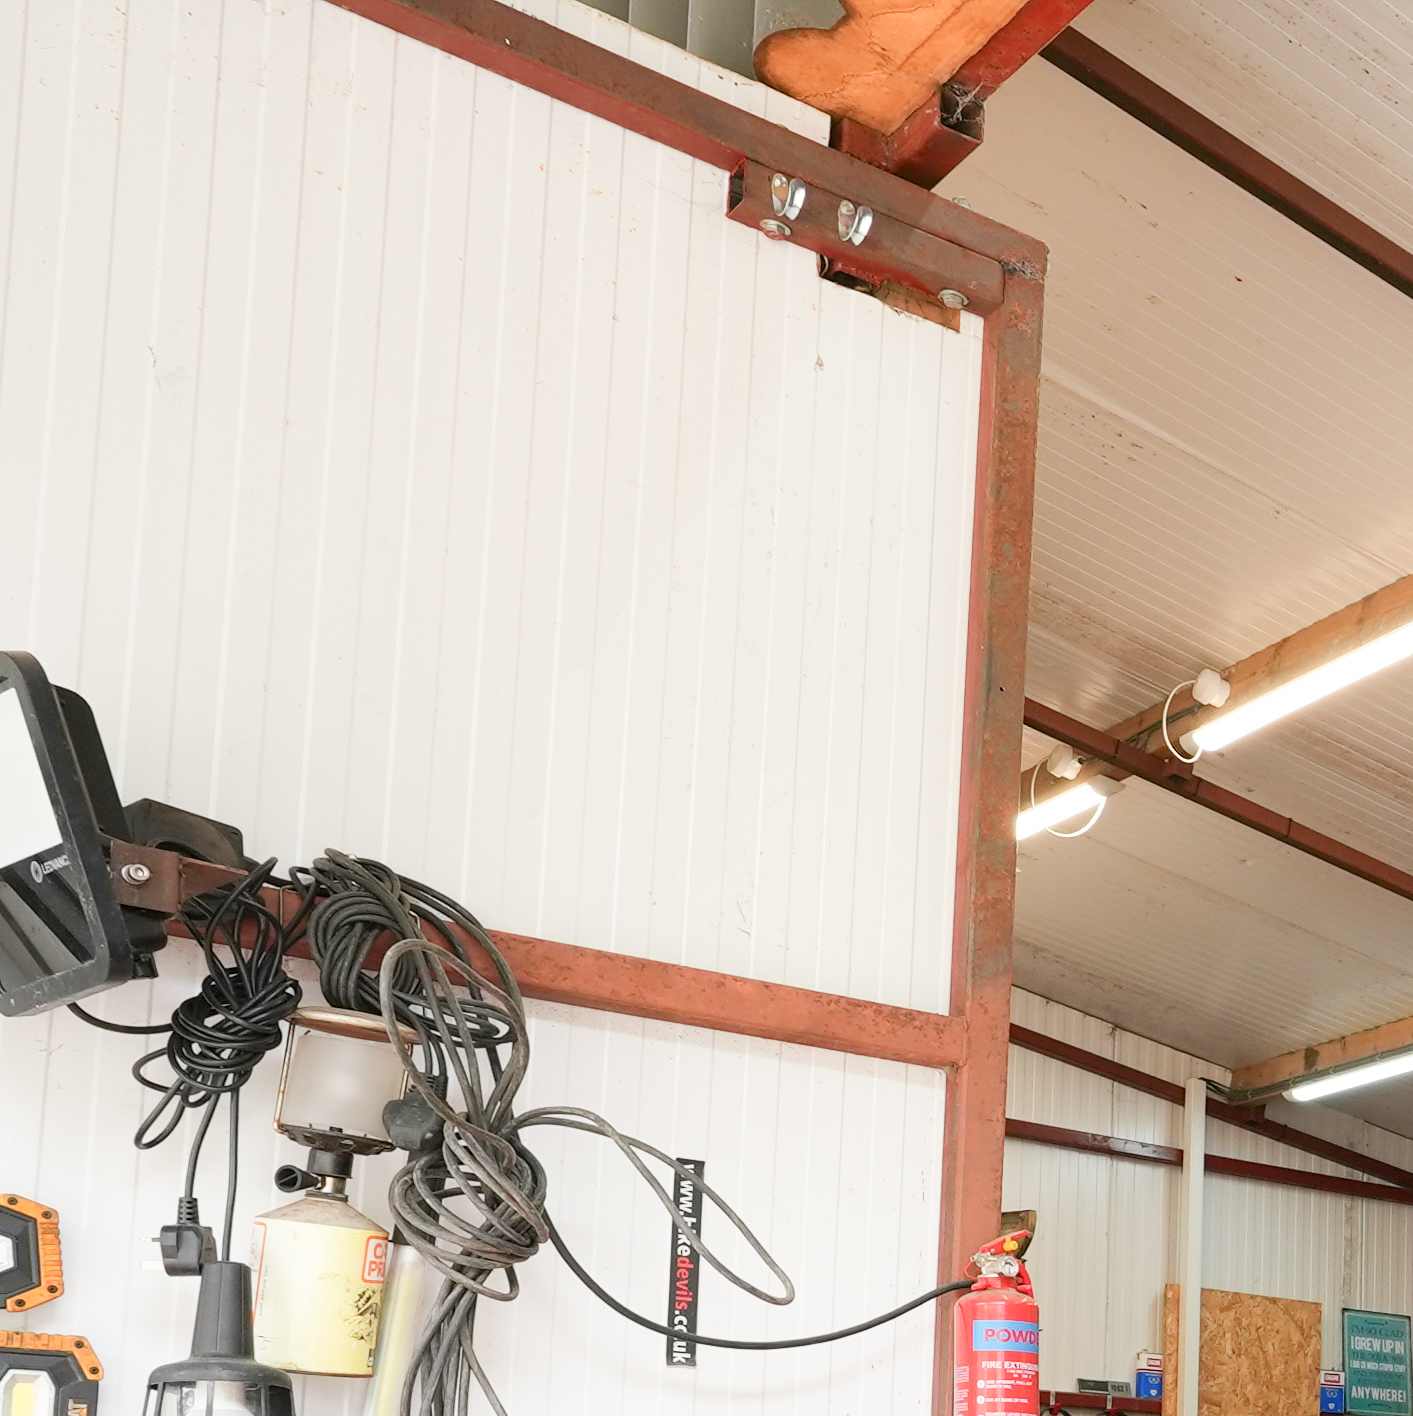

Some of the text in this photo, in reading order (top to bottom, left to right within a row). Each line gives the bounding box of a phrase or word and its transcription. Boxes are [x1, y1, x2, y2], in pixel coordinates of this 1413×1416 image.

[41, 855, 71, 875] LEDVANC
[671, 1163, 698, 1365] ww.bkedevils.couk
[984, 1328, 1039, 1346] POWD
[1354, 1335, 1381, 1353] GREW
[1382, 1338, 1395, 1353] UP
[1395, 1340, 1405, 1355] IN
[982, 1361, 1002, 1369] FIRE
[1350, 1385, 1407, 1403] ANYWHERE!
